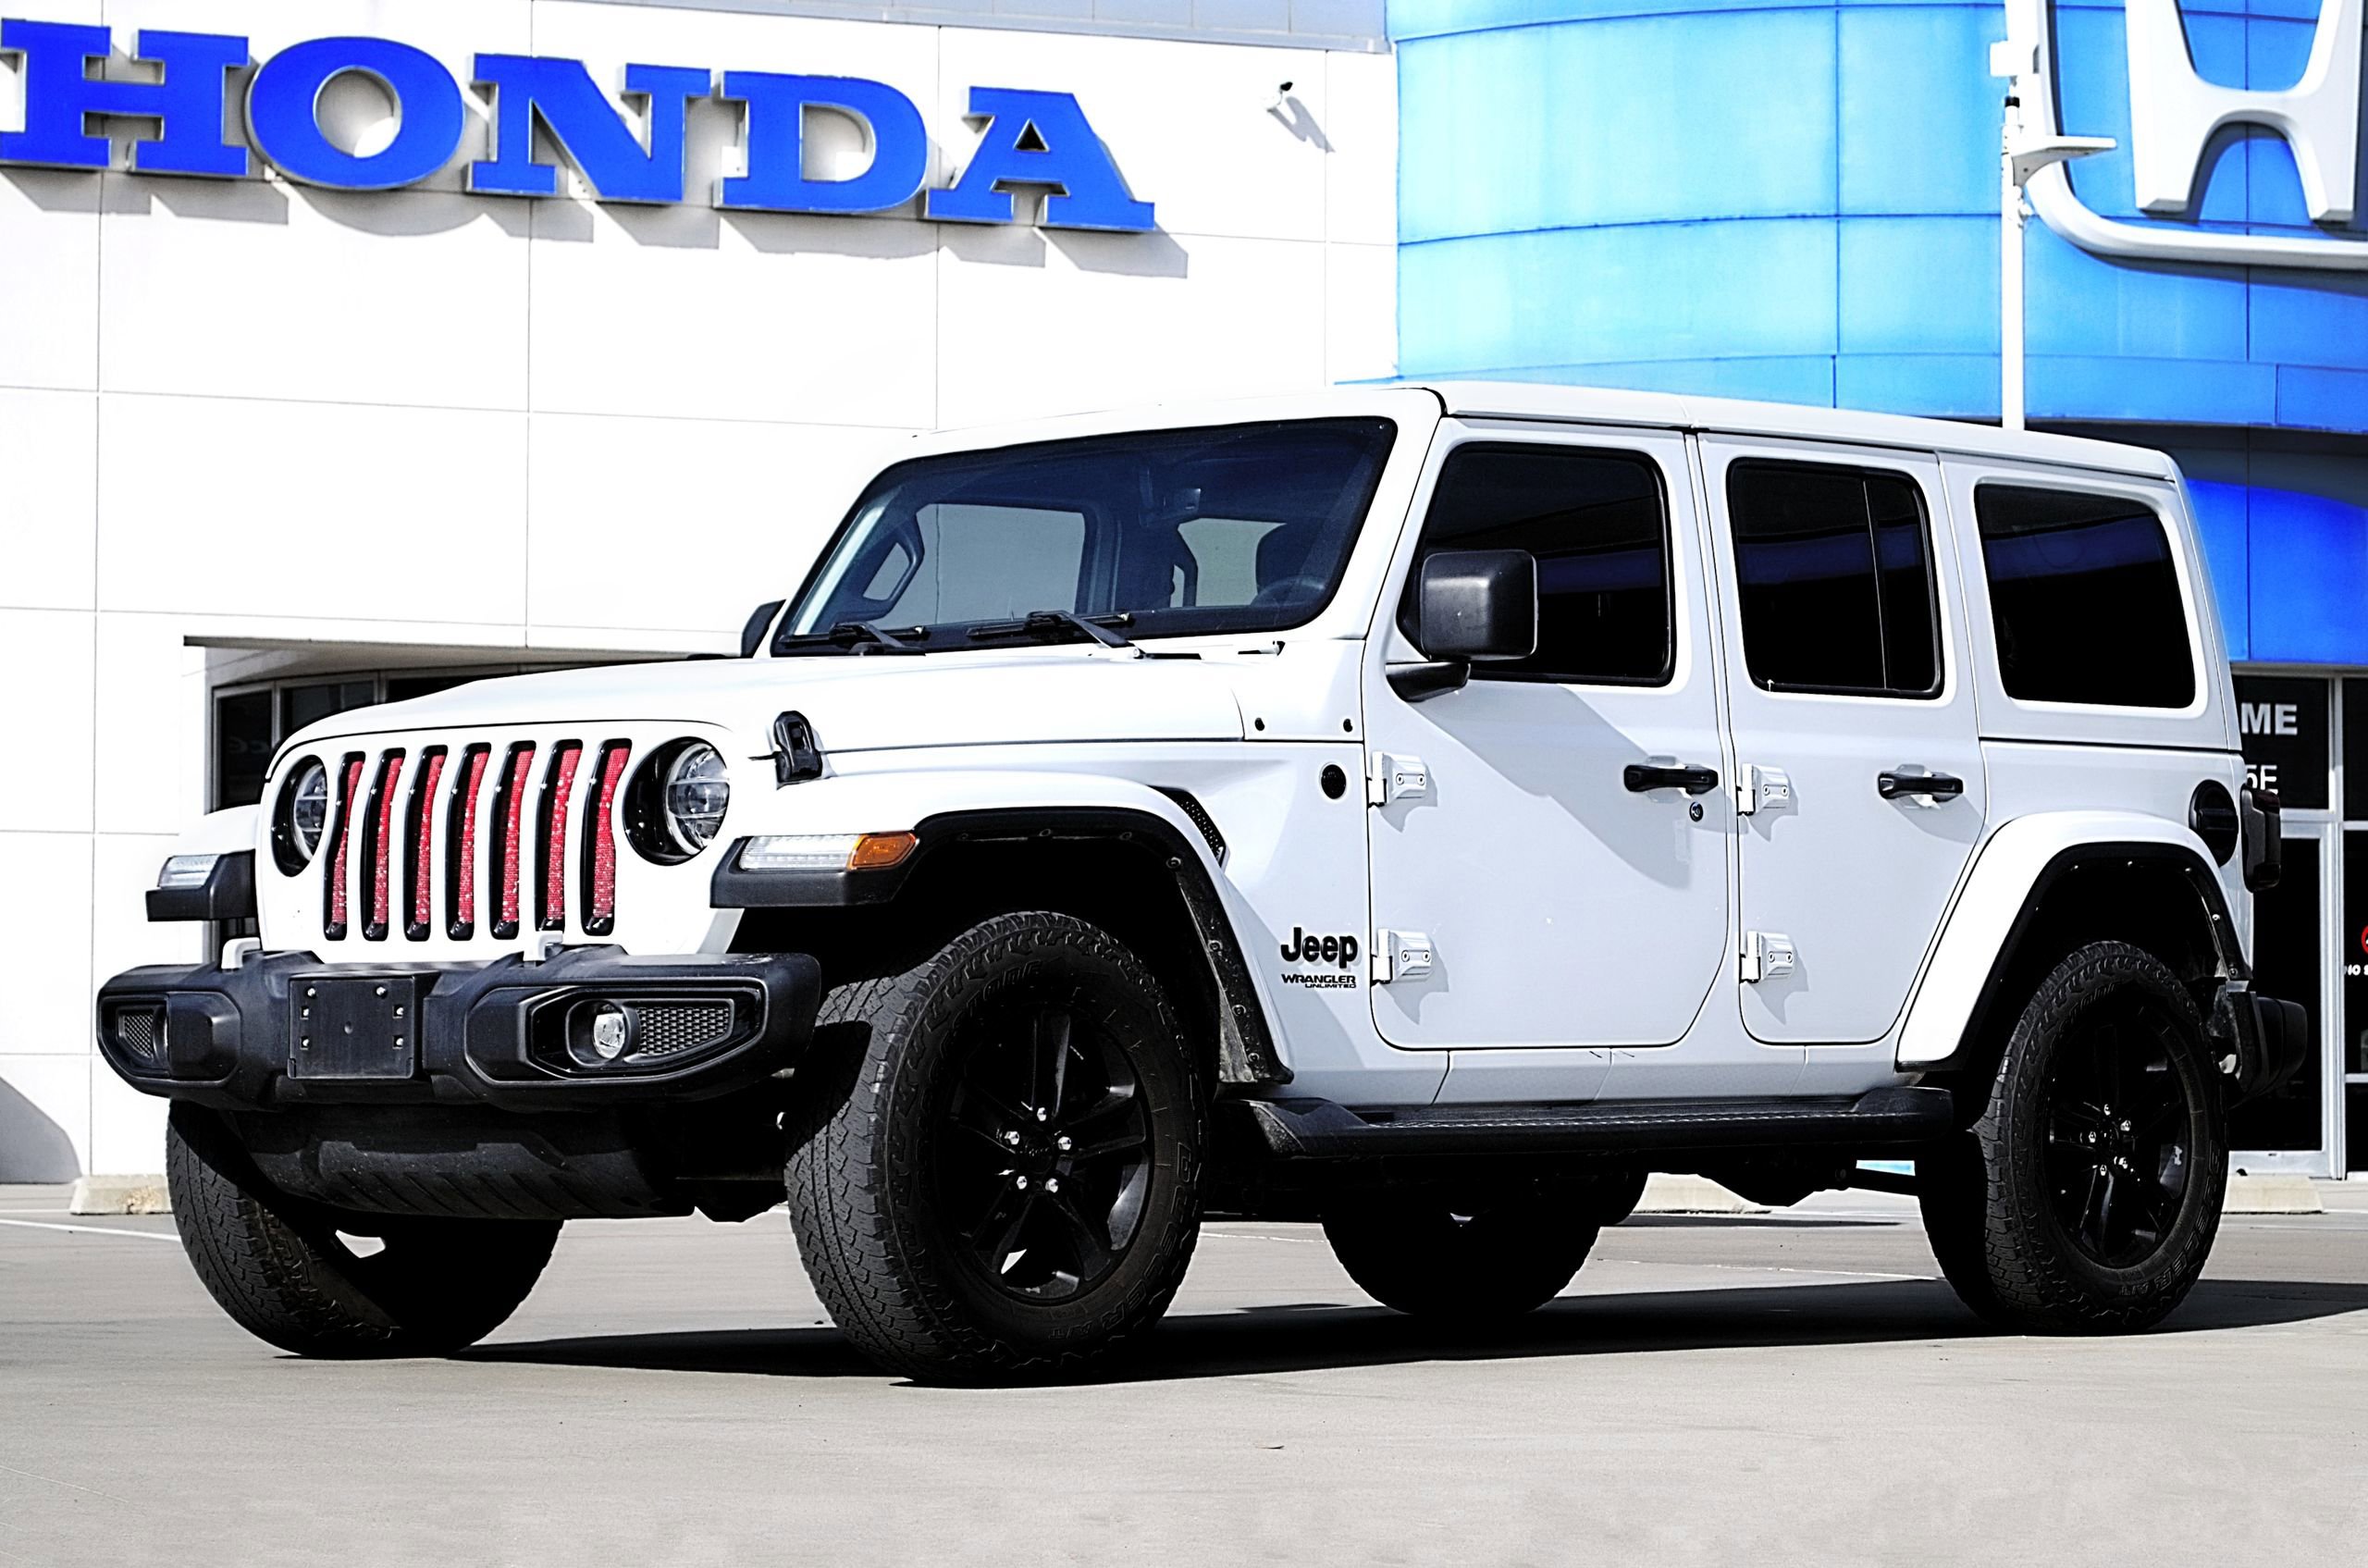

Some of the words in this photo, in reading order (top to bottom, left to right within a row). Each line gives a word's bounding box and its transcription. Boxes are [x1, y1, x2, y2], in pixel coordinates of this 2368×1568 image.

[0, 18, 1155, 230] HONDA
[1280, 926, 1359, 969] Jeep
[1280, 973, 1356, 984] WRANGLER
